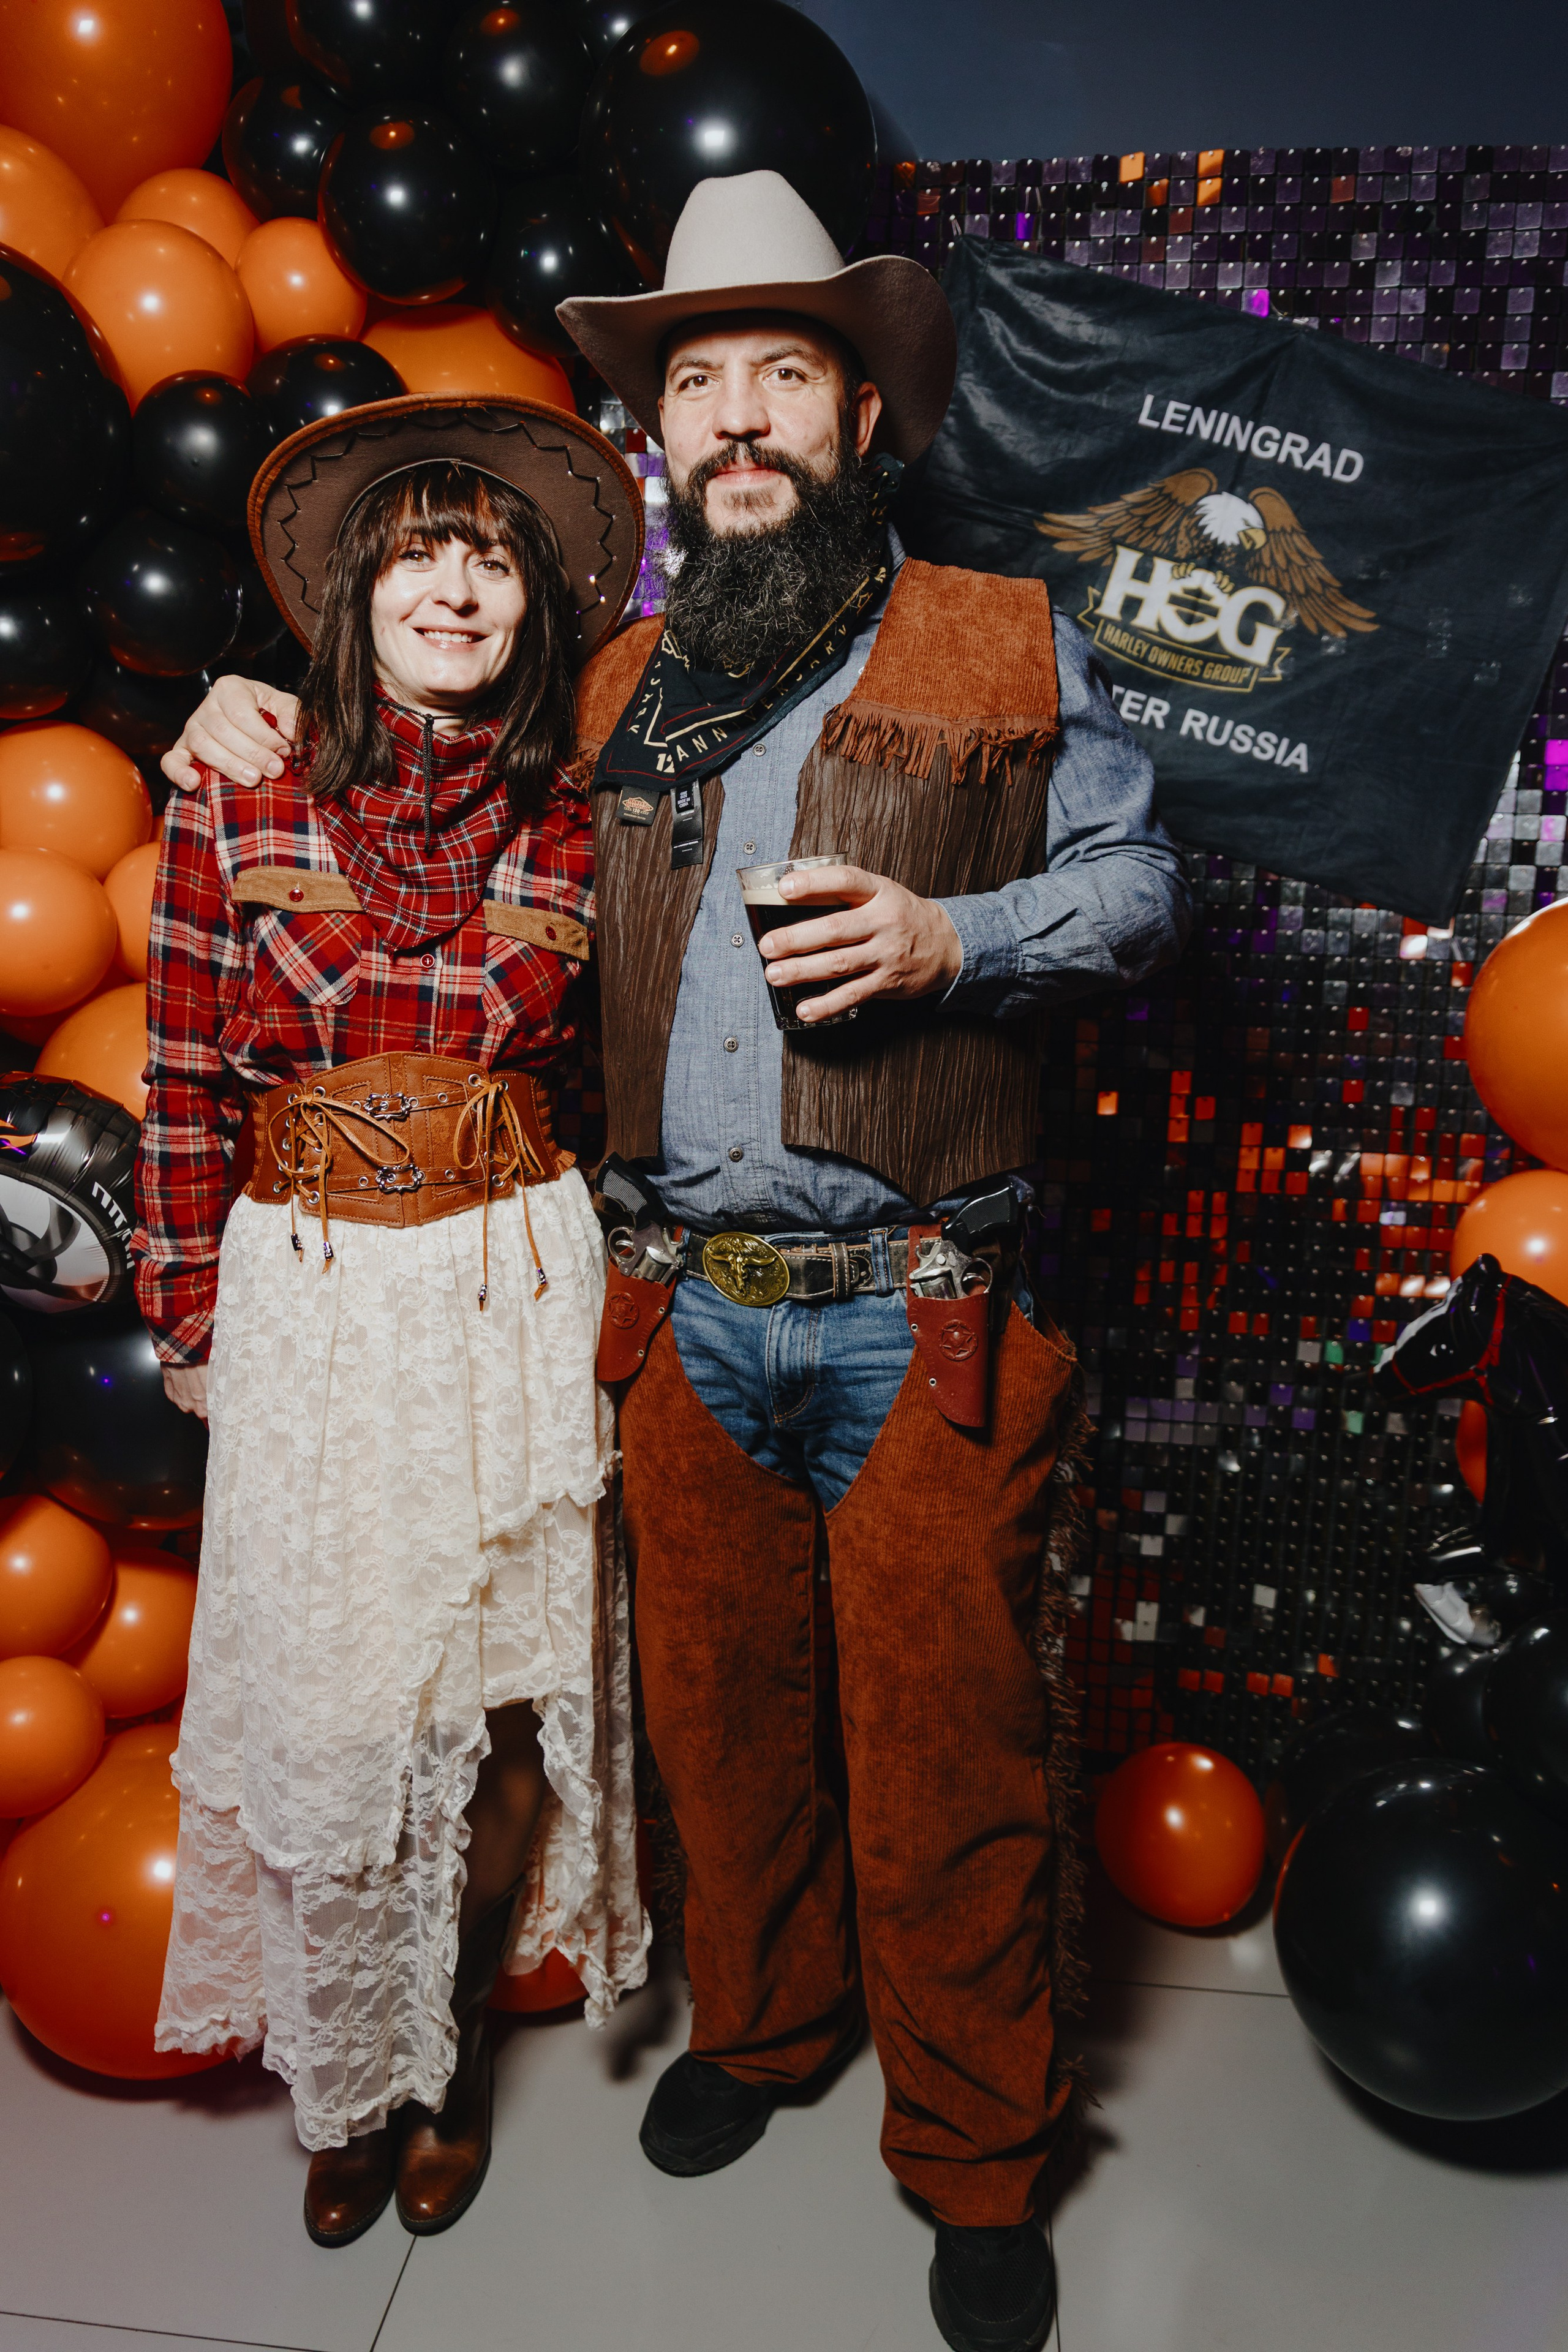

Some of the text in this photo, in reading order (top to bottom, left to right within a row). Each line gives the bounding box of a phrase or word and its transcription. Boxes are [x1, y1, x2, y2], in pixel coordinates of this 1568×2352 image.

[1138, 394, 1364, 483] LENINGRAD
[1094, 545, 1286, 666] HOG
[1103, 624, 1251, 684] HARLEY OWNERS GROUP
[656, 753, 675, 773] 12
[1112, 684, 1308, 773] TER RUSSIA
